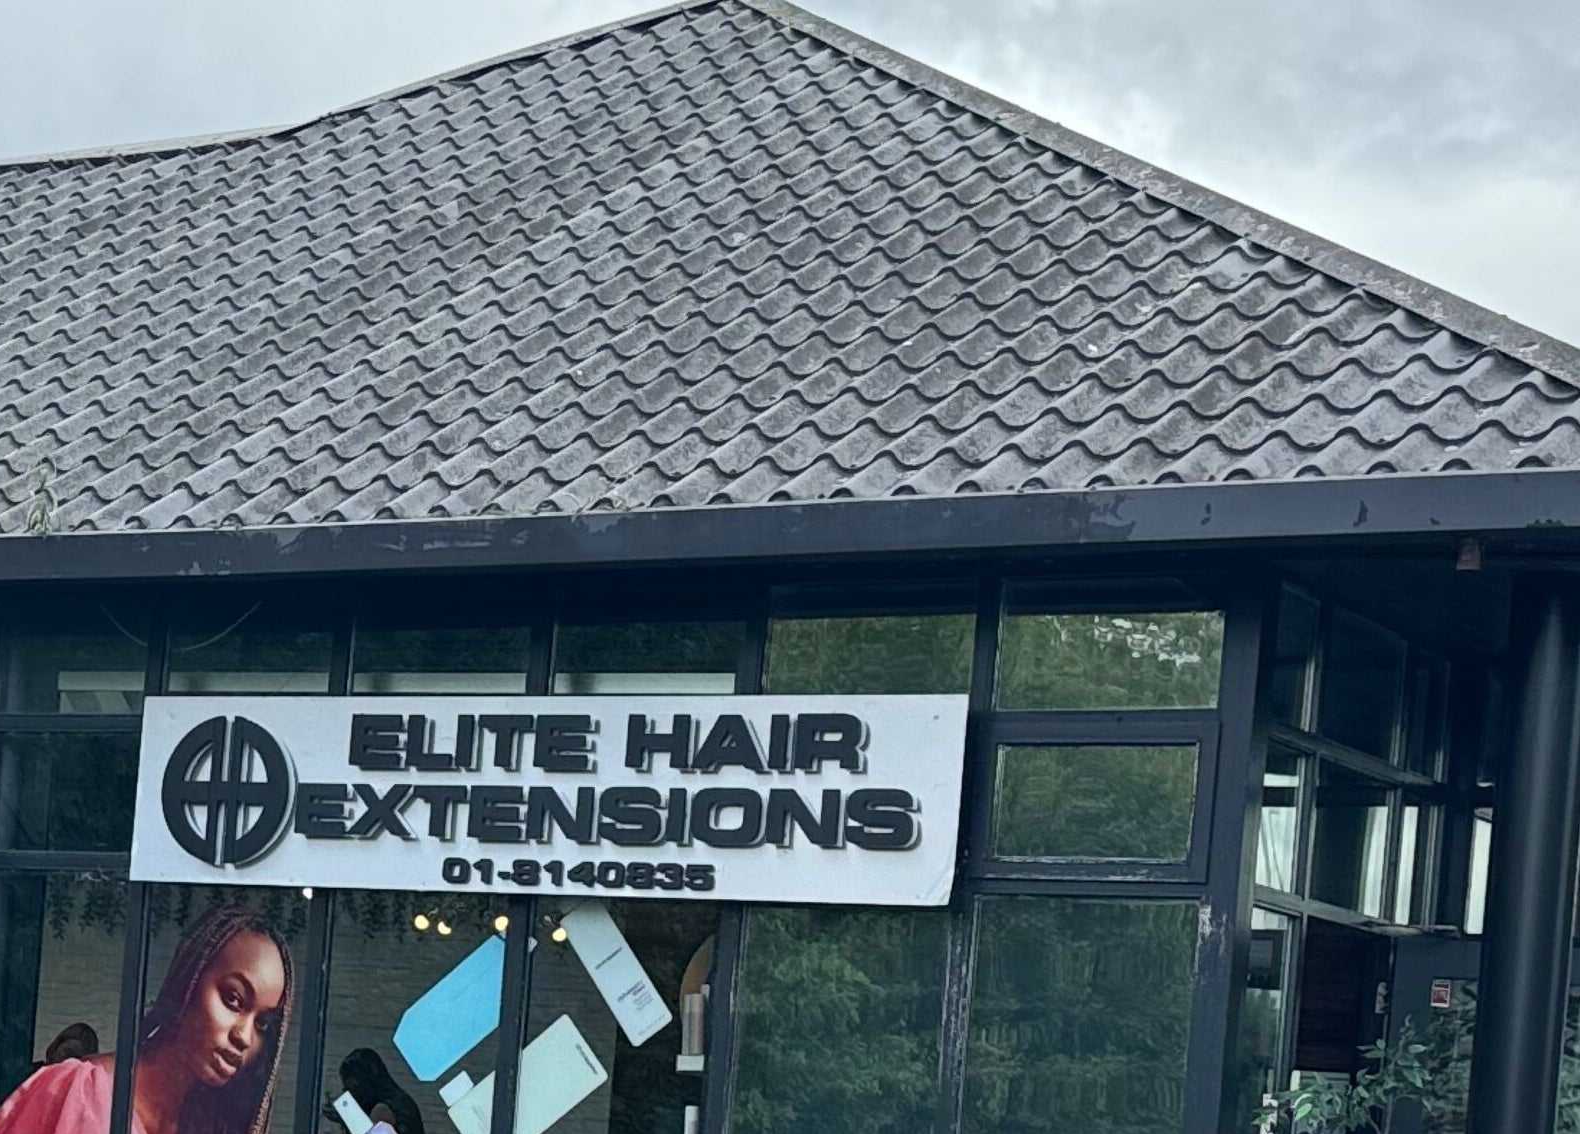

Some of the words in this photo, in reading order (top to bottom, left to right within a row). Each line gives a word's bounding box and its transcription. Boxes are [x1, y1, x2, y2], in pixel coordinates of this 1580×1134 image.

[349, 713, 597, 771] ELITE
[625, 713, 868, 772] HAIR
[295, 783, 918, 849] EXTENSIONS
[442, 857, 716, 891] 01-8140835
